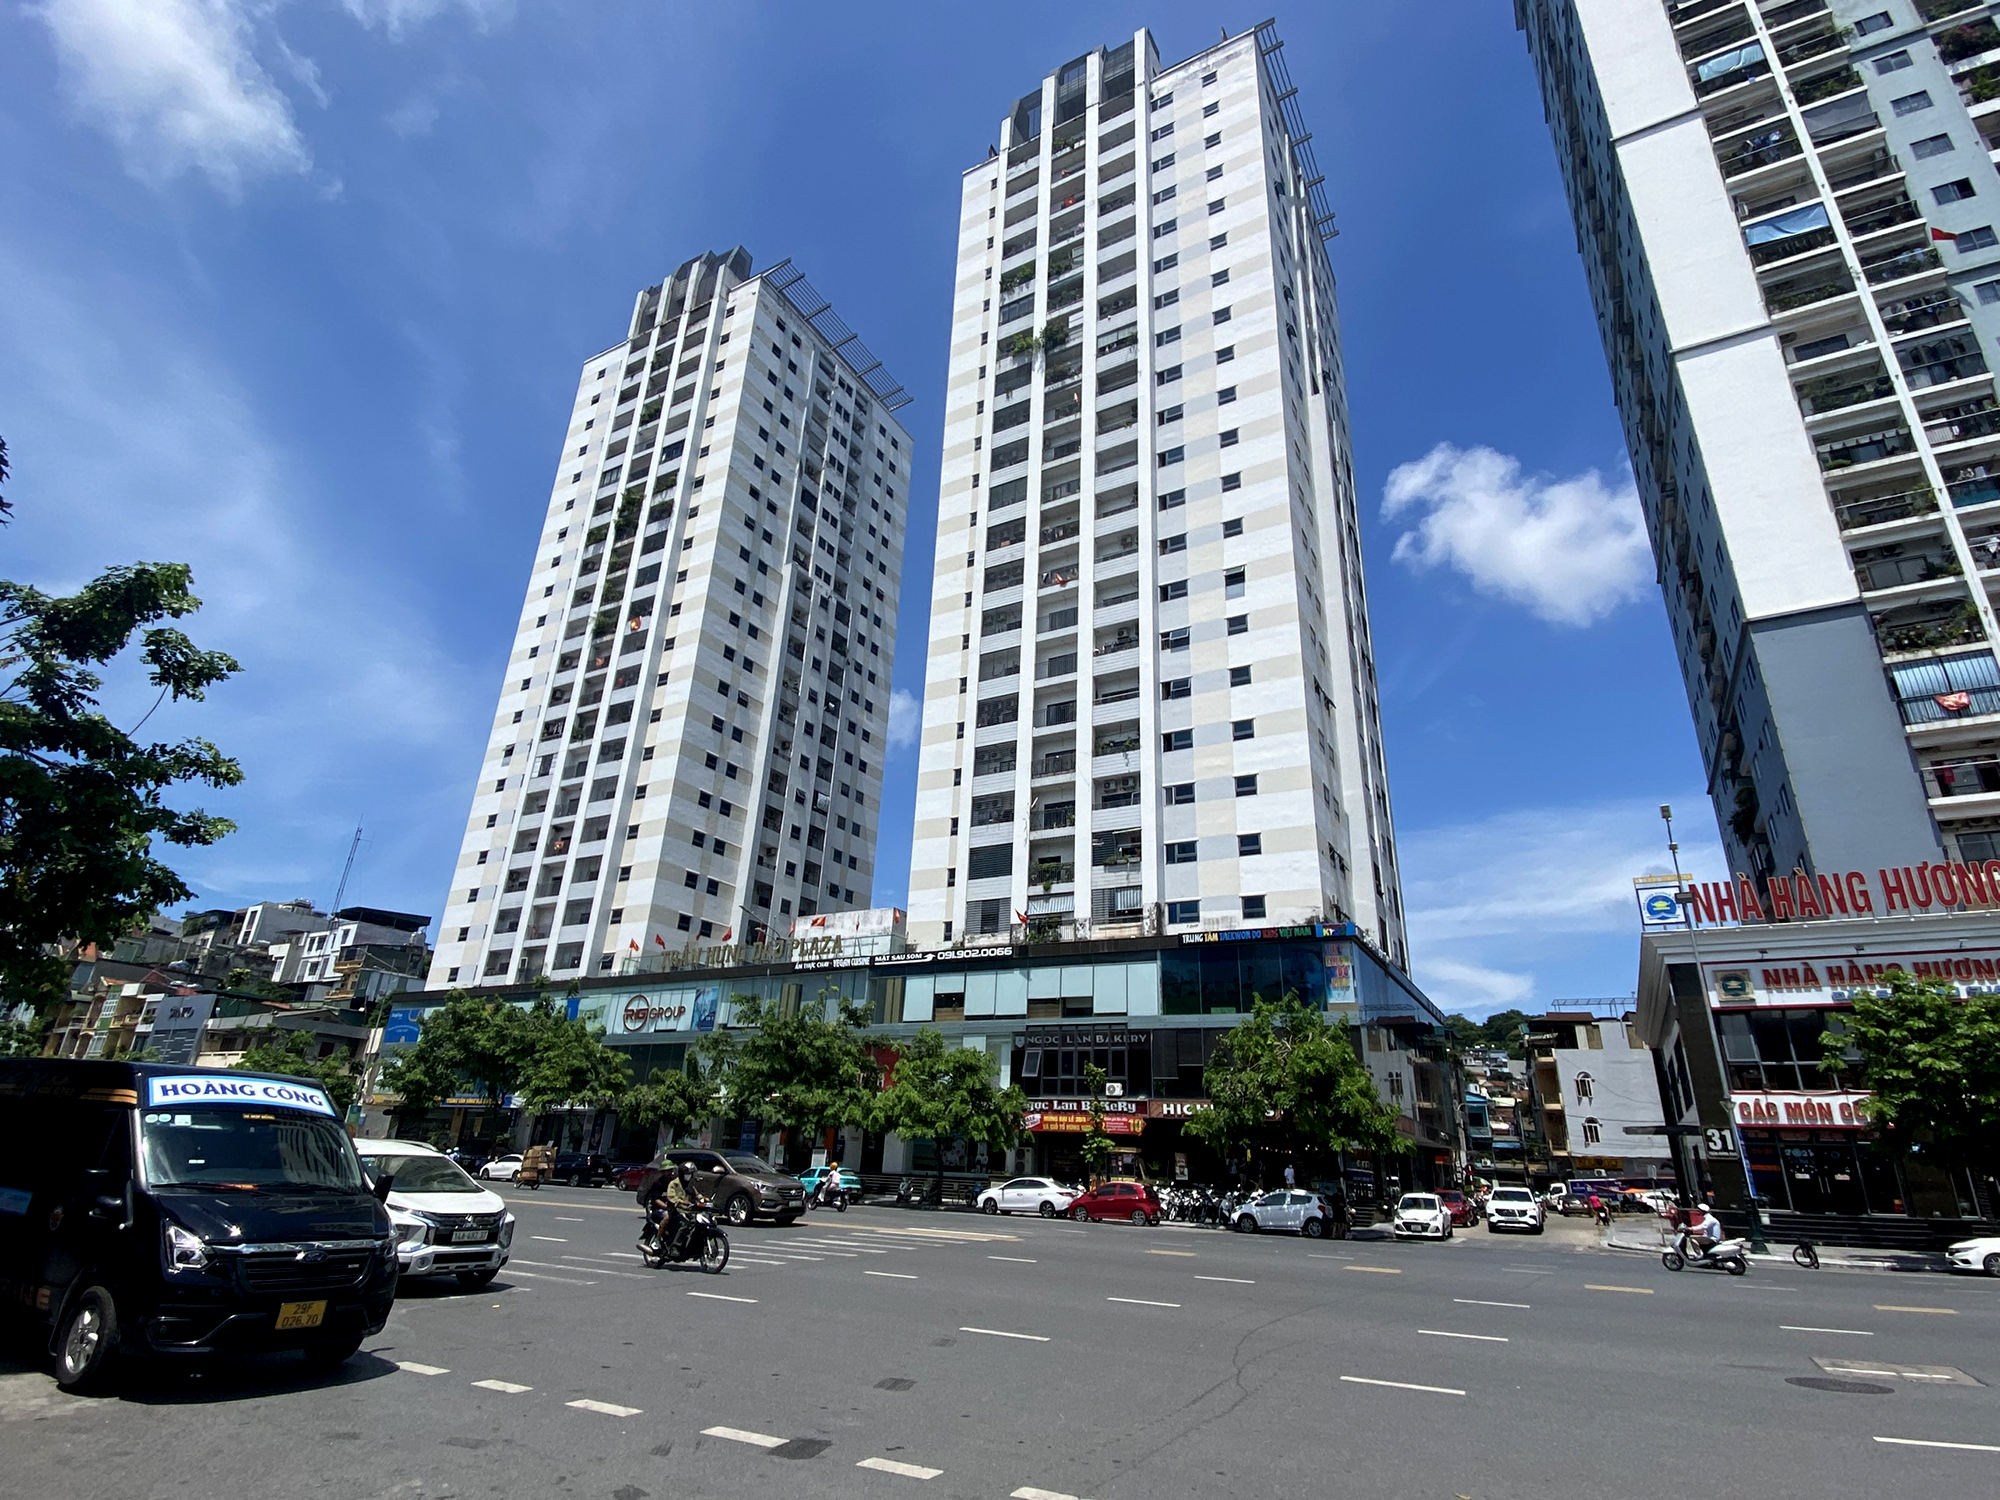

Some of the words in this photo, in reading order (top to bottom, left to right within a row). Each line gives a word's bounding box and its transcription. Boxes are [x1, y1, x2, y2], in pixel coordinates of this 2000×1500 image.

[1688, 872, 1763, 923] NHÀ
[1768, 868, 1872, 918] HÀNG
[1182, 934, 1203, 943] TRUNG
[1204, 932, 1218, 942] TÂM
[1220, 930, 1250, 941] TAEKWON
[1251, 930, 1261, 939] DO
[1262, 928, 1278, 938] KIDS
[1279, 927, 1293, 938] VIỆT
[1294, 927, 1311, 936] NAM
[789, 935, 843, 958] PLAZA
[937, 947, 1012, 960] 091.902.0066
[833, 958, 851, 968] VEGAN
[851, 956, 870, 966] CUISINE
[1762, 962, 1822, 988] NHÀ
[1912, 958, 2000, 981] HƯƠN
[649, 1006, 686, 1019] GROUP
[1066, 1035, 1091, 1043] LAN
[1096, 1034, 1147, 1043] BAKERY
[161, 1080, 256, 1097] HOÀNG
[262, 1085, 323, 1106] CÔNG
[1053, 1100, 1077, 1110] Lan
[1707, 1129, 1734, 1150] 31
[293, 1302, 314, 1315] 29F
[282, 1314, 319, 1327] 026.70
